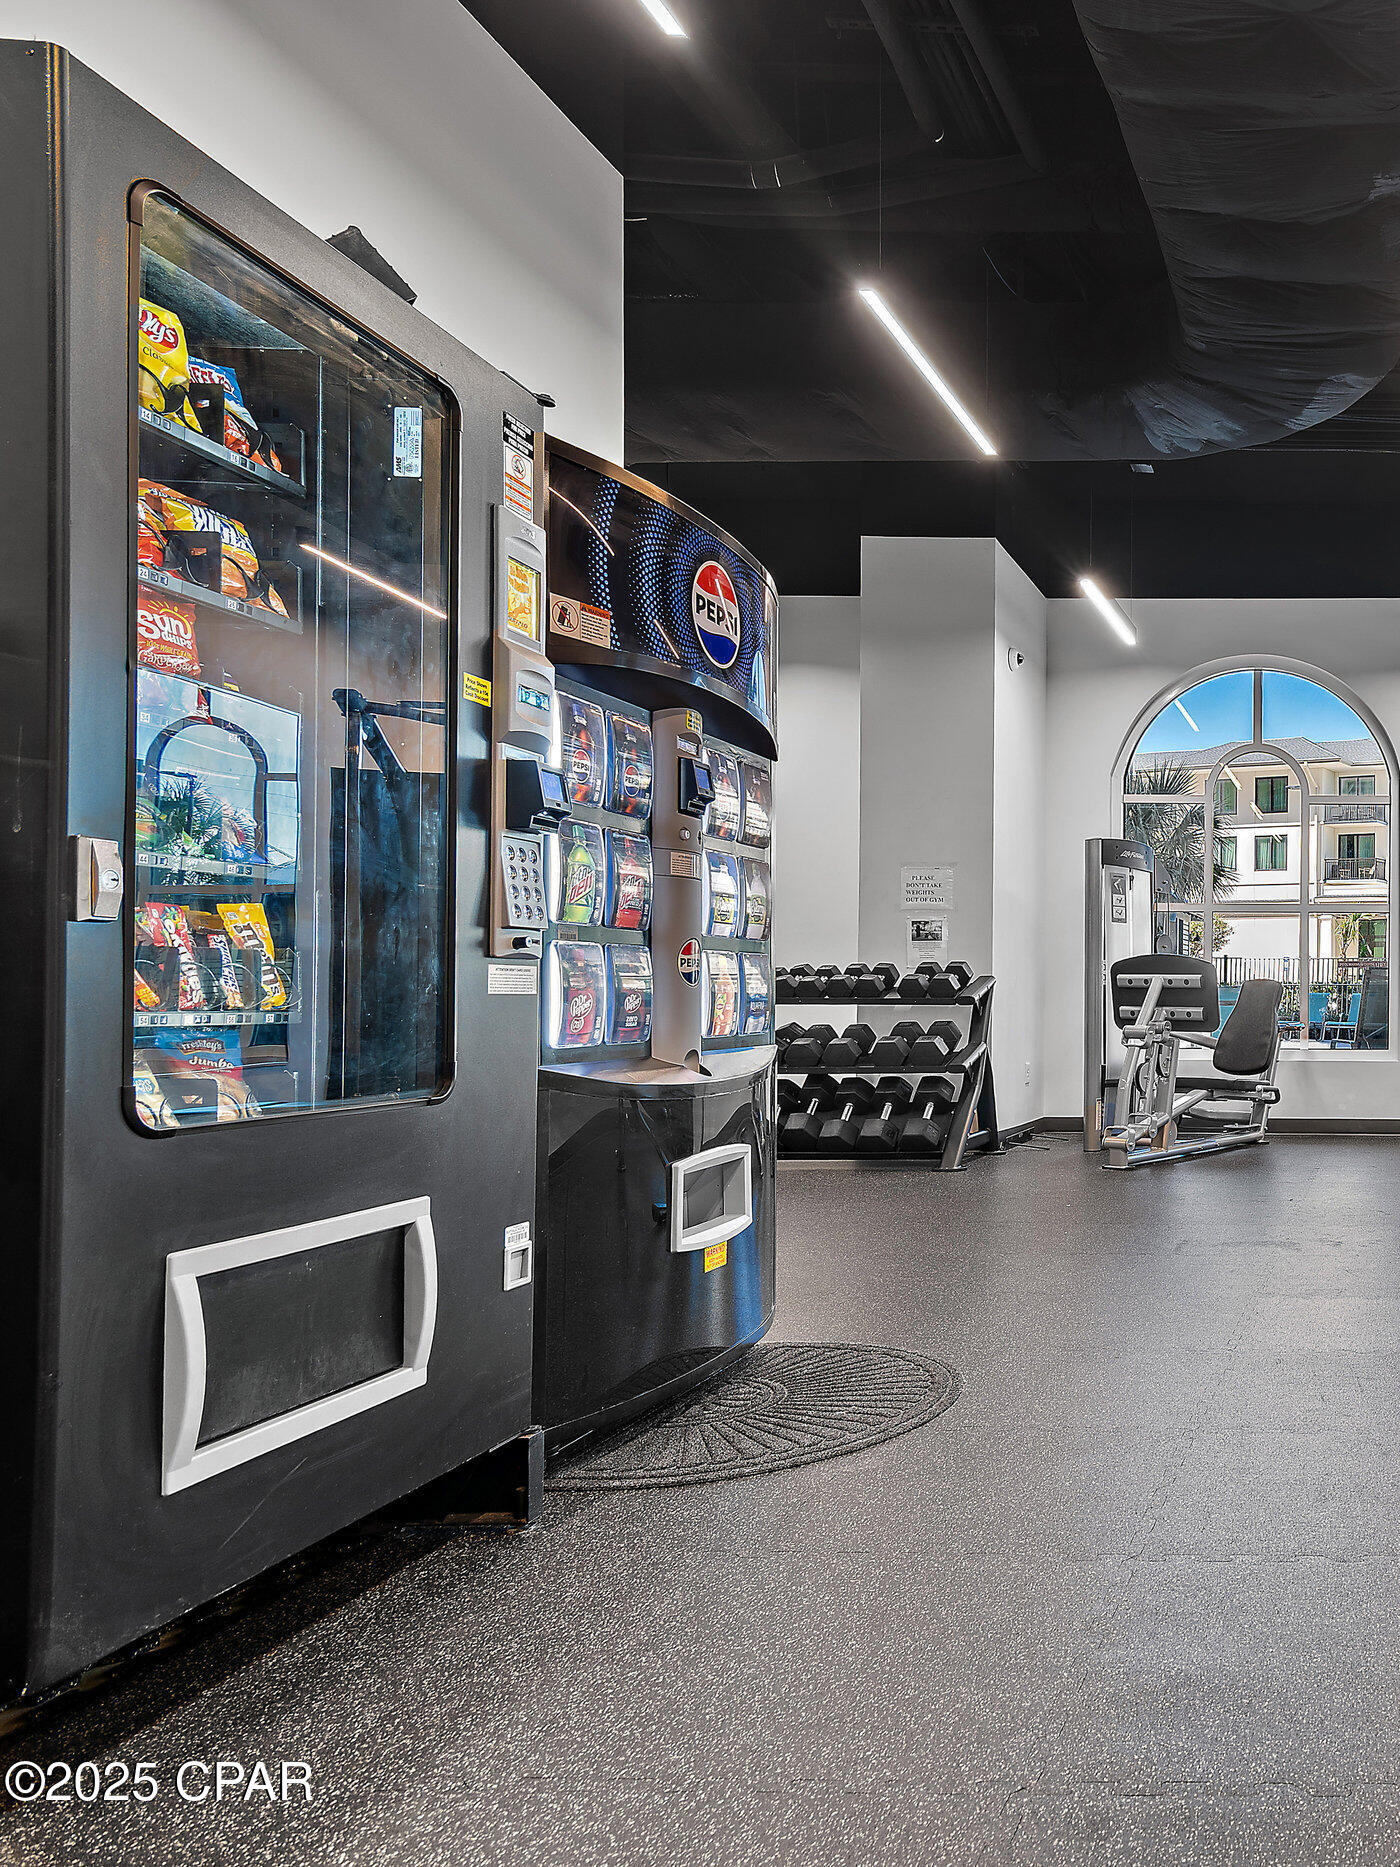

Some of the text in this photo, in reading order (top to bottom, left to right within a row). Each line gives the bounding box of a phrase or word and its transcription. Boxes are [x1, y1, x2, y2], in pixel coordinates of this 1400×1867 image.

[139, 567, 148, 576] 24
[695, 591, 739, 638] PEPSI
[680, 957, 701, 969] PEPS
[188, 1055, 235, 1069] Jumbo
